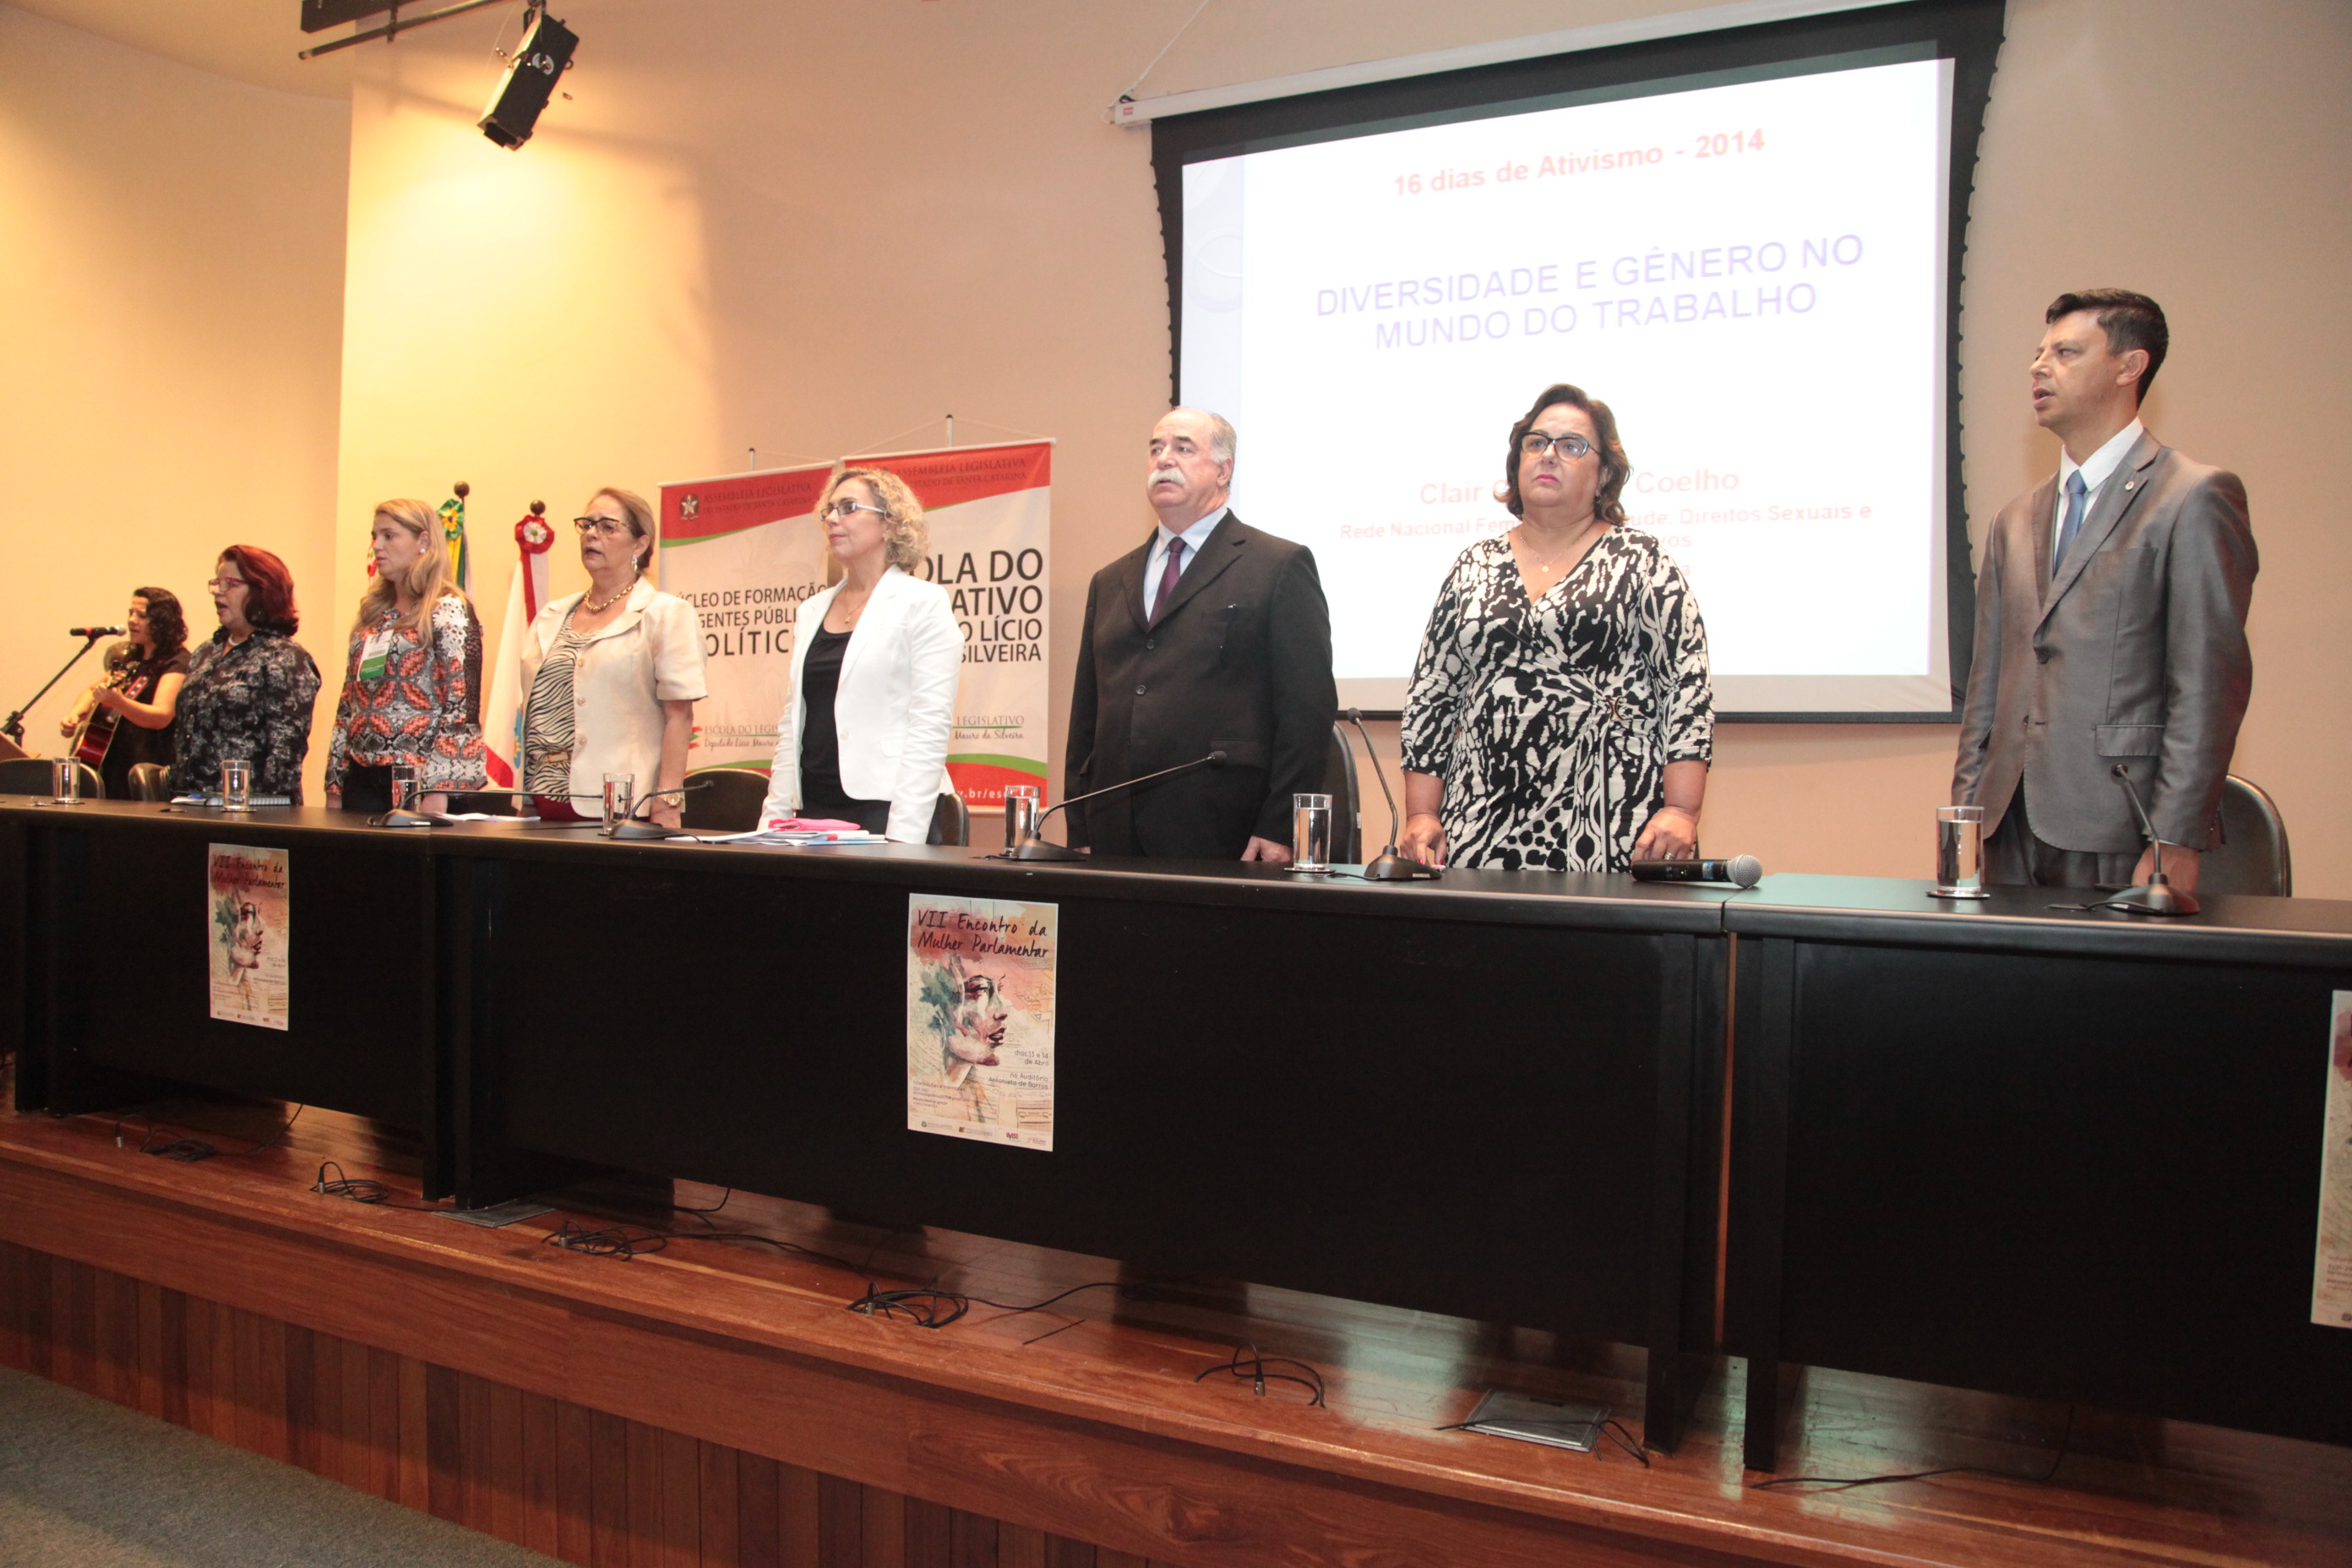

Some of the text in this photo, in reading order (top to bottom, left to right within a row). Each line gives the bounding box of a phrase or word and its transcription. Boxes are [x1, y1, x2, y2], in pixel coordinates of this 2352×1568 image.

[1395, 173, 1422, 196] 16
[1430, 169, 1487, 191] dias
[1496, 161, 1530, 182] de
[1538, 147, 1663, 177] Ativismo
[1696, 128, 1767, 158] 2014
[1317, 235, 1864, 316] DIVERSIDADE E GÊNERO NO
[1375, 282, 1816, 349] MUNDO DO TRABALHO
[959, 457, 1026, 472] LEGISLATIVA
[1419, 483, 1484, 504] Clair
[1636, 469, 1740, 495] Coelho
[1340, 523, 1386, 539] Rede
[1390, 518, 1472, 536] Nacional
[1680, 508, 1762, 525] Direitos
[1767, 502, 1853, 521] Sexuais
[1858, 504, 1871, 518] e
[910, 548, 1043, 585] OLA DO
[722, 591, 741, 606] DE
[952, 585, 1043, 616] ATIVO
[698, 607, 797, 629] GENTES PÚBLI
[980, 615, 1043, 641] LÍCIO
[705, 627, 790, 656] OLÍTIC
[961, 643, 1041, 663] SILVEIRA
[705, 724, 778, 735] ESCOLA DO LEGIS
[956, 715, 1025, 726] LEGISLATIVO
[982, 728, 991, 739] da
[994, 728, 1025, 740] Silveira
[274, 861, 284, 874] da
[917, 910, 1048, 937] VII Encontro da
[917, 932, 1049, 958] Mulher Parlamentar
